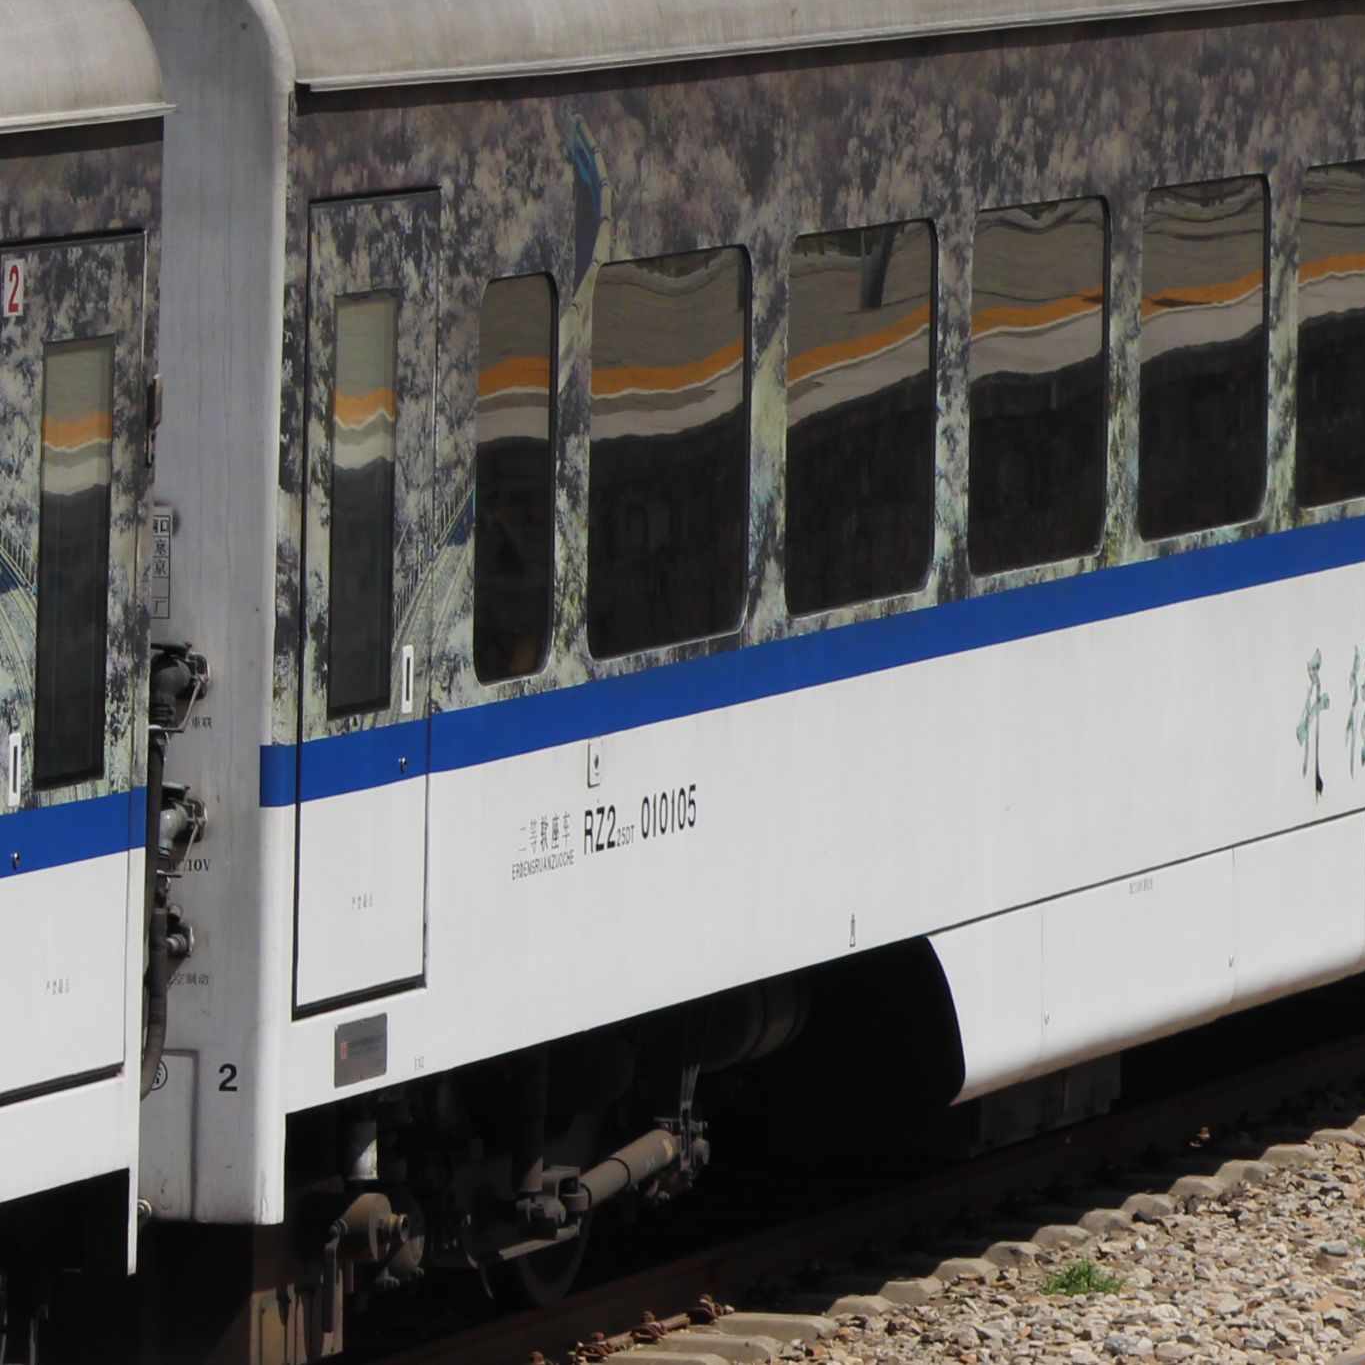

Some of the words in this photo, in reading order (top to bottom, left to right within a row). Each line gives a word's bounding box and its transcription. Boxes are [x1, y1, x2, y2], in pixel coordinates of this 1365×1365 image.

[8, 264, 20, 313] 2
[518, 811, 571, 854] 二等软座车
[641, 783, 697, 839] 010105
[218, 1063, 238, 1092] 2
